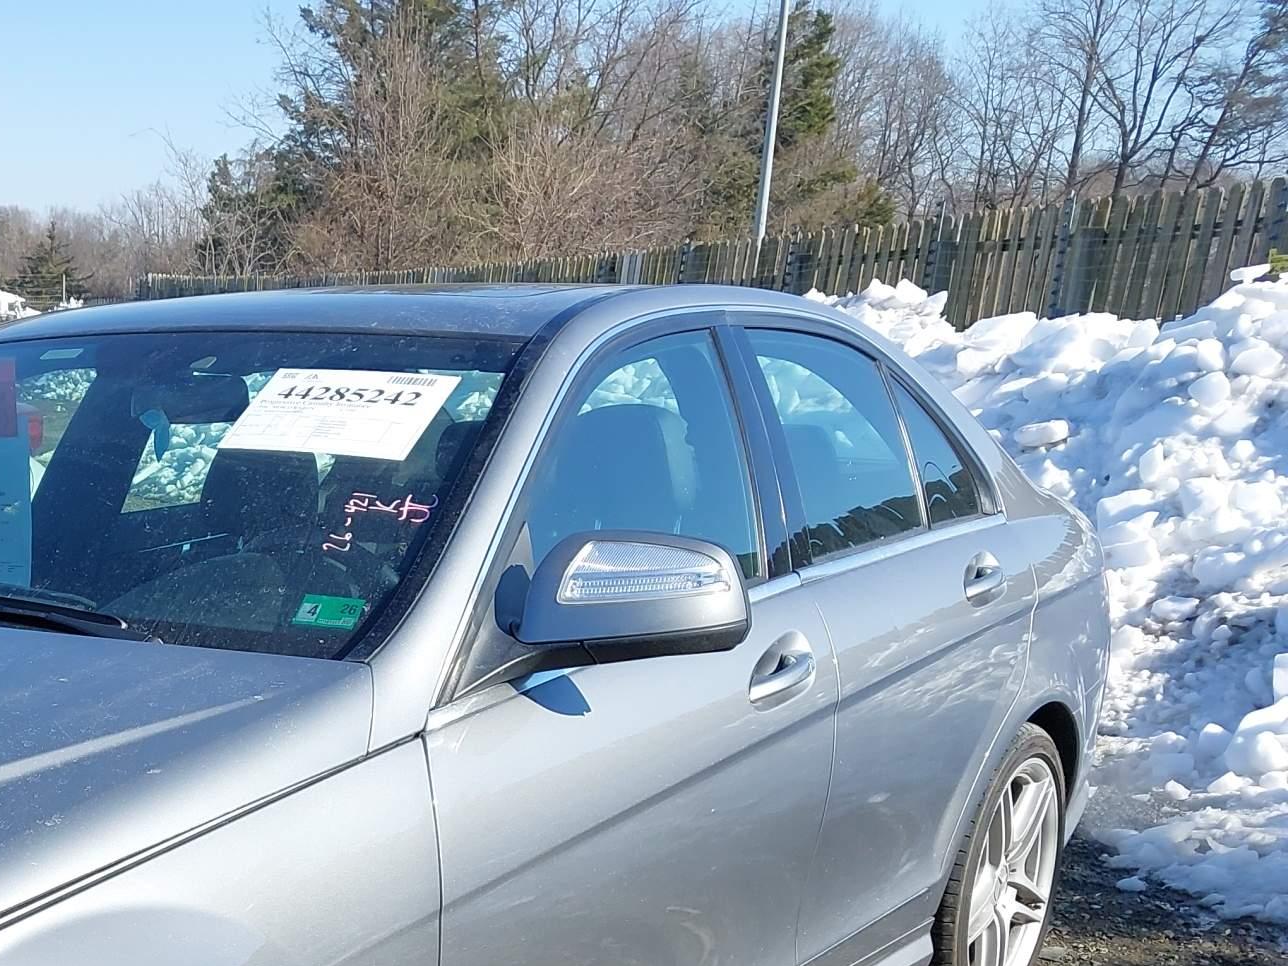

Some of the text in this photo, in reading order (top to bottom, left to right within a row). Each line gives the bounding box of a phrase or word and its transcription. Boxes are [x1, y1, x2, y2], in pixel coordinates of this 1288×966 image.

[277, 384, 423, 406] 44285242
[306, 603, 357, 616] 4 26
